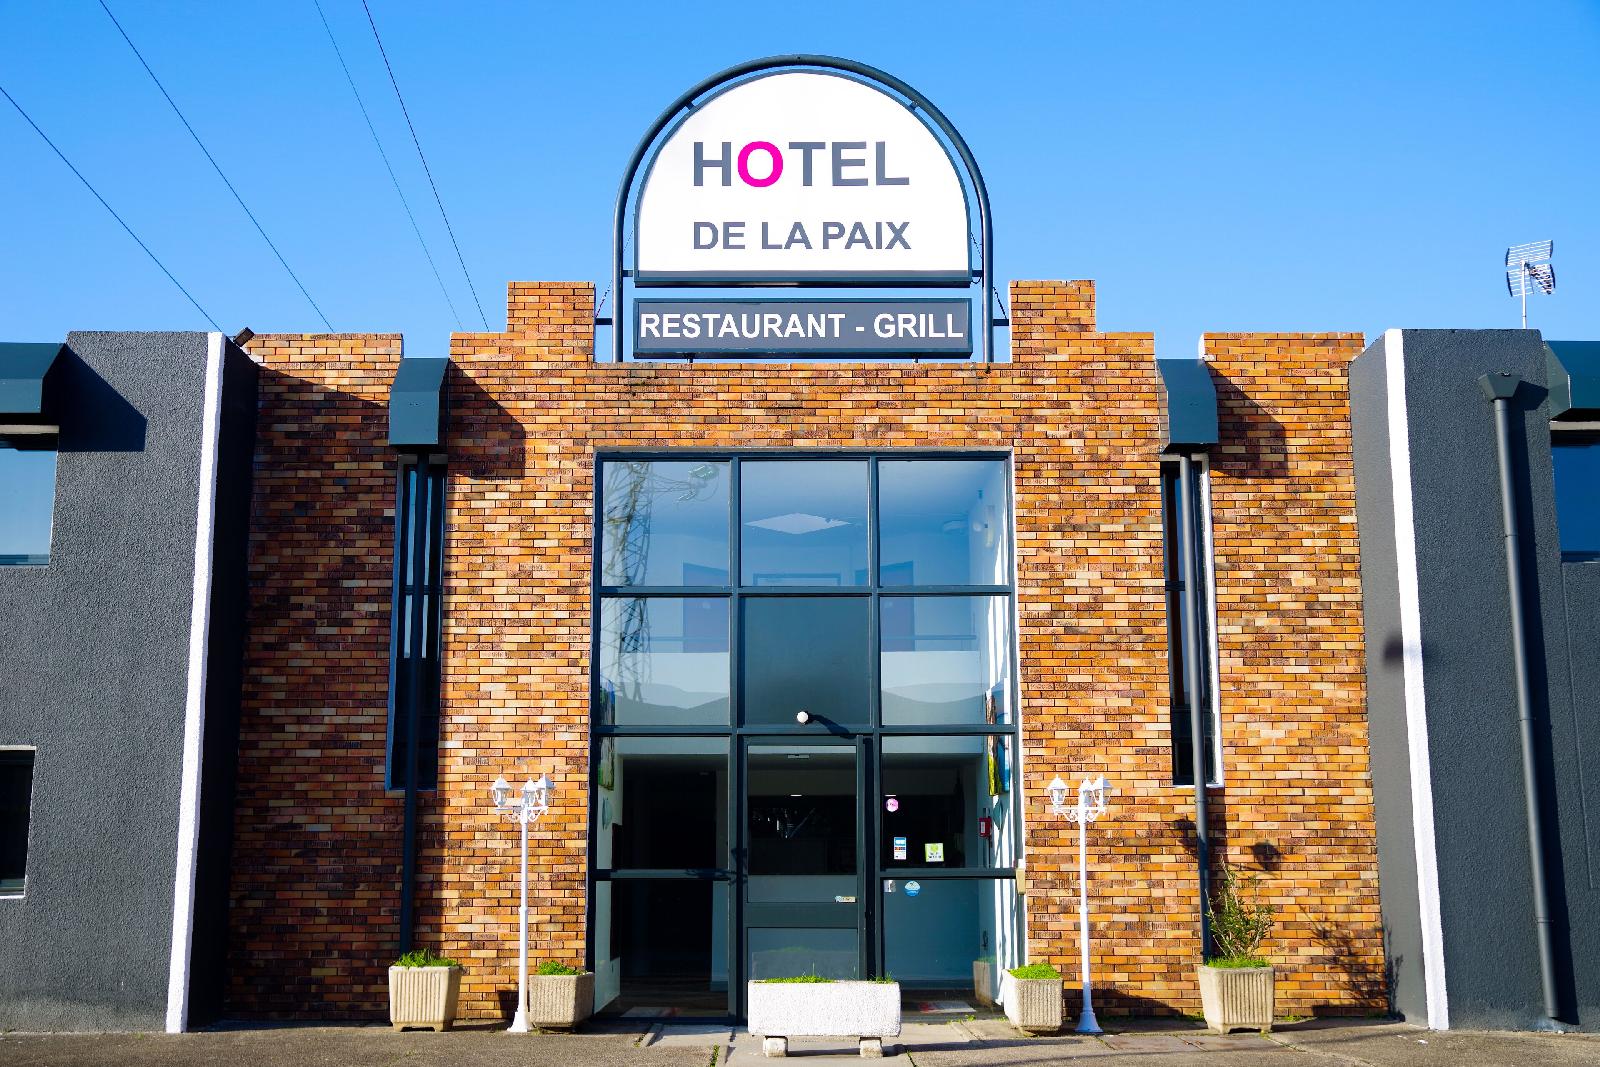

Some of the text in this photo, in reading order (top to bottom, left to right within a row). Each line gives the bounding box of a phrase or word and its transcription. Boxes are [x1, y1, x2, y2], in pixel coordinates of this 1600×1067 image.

[693, 141, 910, 188] HOTEL
[693, 222, 912, 250] DE LA PAIX
[640, 313, 846, 339] RESTAURANT
[873, 313, 964, 339] GRILL
